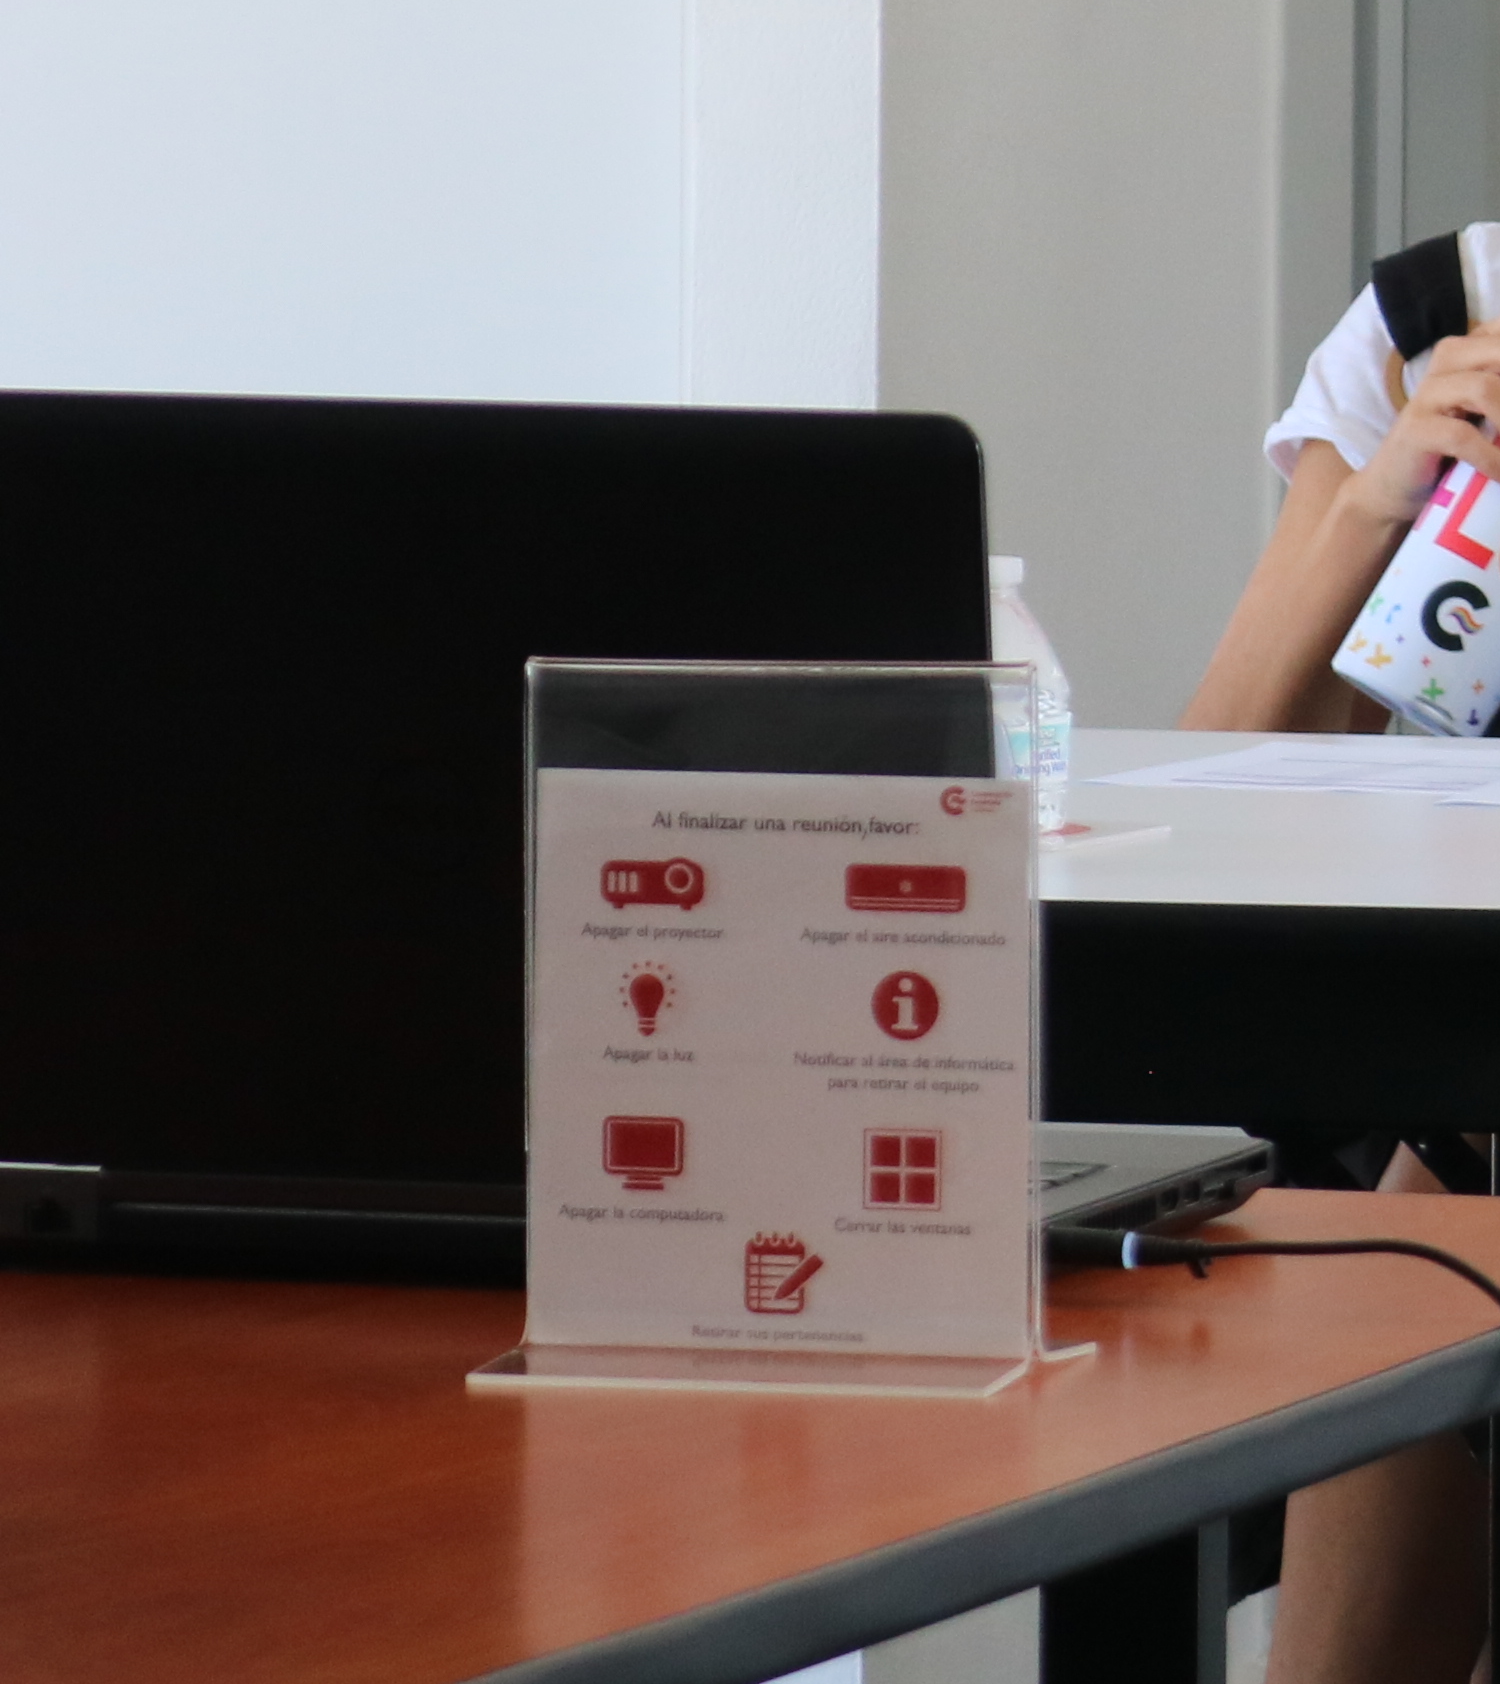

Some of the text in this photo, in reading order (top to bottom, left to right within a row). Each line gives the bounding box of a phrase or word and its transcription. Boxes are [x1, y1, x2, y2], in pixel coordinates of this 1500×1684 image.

[652, 812, 671, 828] Al
[679, 813, 747, 831] finalizar
[755, 818, 786, 832] una
[581, 922, 725, 942] Apagar el proyector
[801, 927, 850, 945] Apagar
[903, 929, 1006, 946] acondicionado
[602, 1045, 652, 1064] Apagar
[827, 1077, 858, 1092] para
[629, 1206, 725, 1223] computadora
